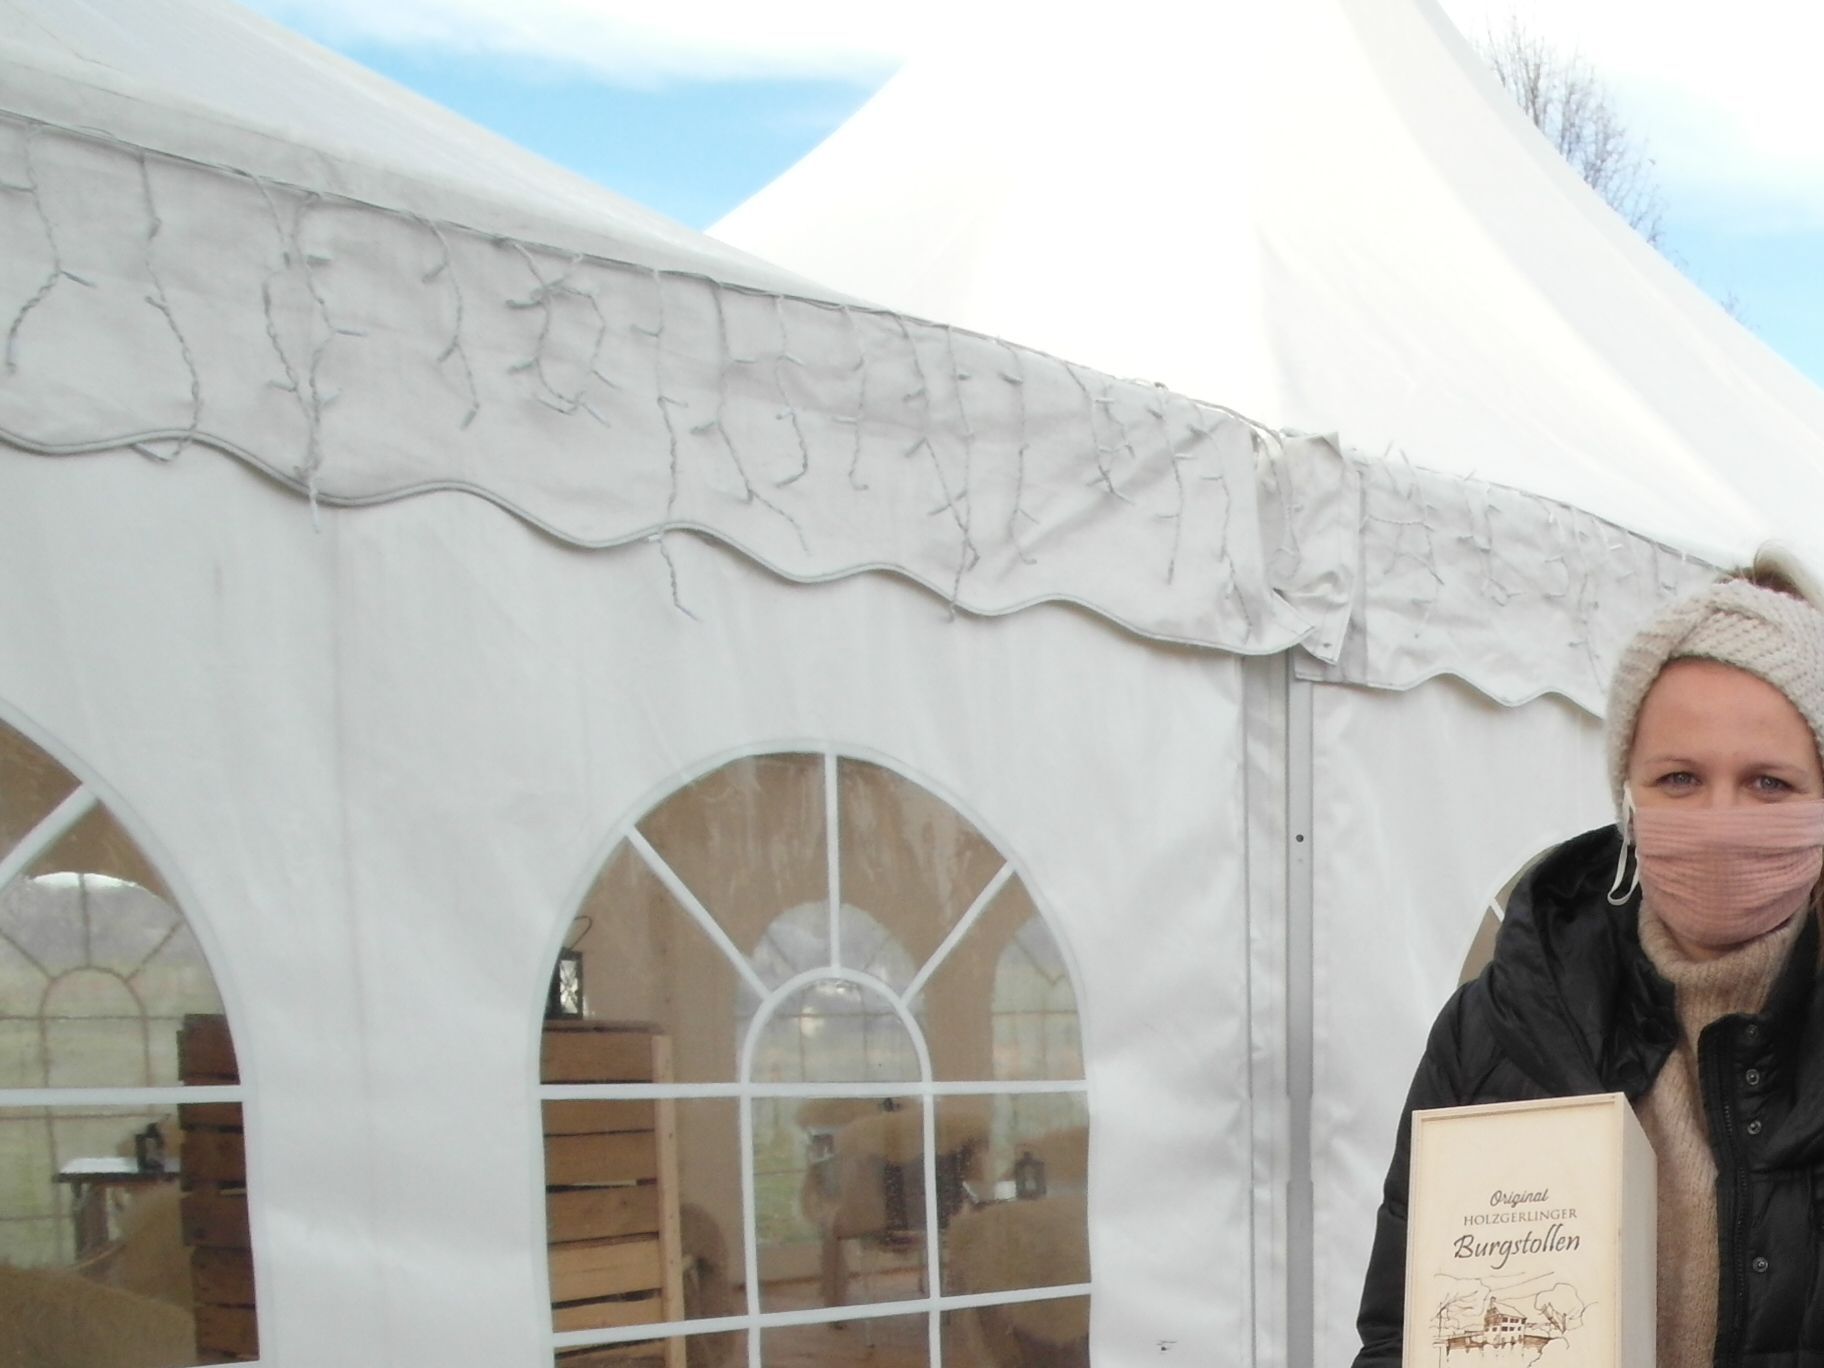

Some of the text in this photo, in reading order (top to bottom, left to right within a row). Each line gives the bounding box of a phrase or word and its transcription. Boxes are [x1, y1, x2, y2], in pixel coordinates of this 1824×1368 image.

[1489, 1187, 1549, 1208] Original
[1463, 1207, 1578, 1226] HOLZGERLINGER
[1452, 1223, 1581, 1269] Burgstollen
